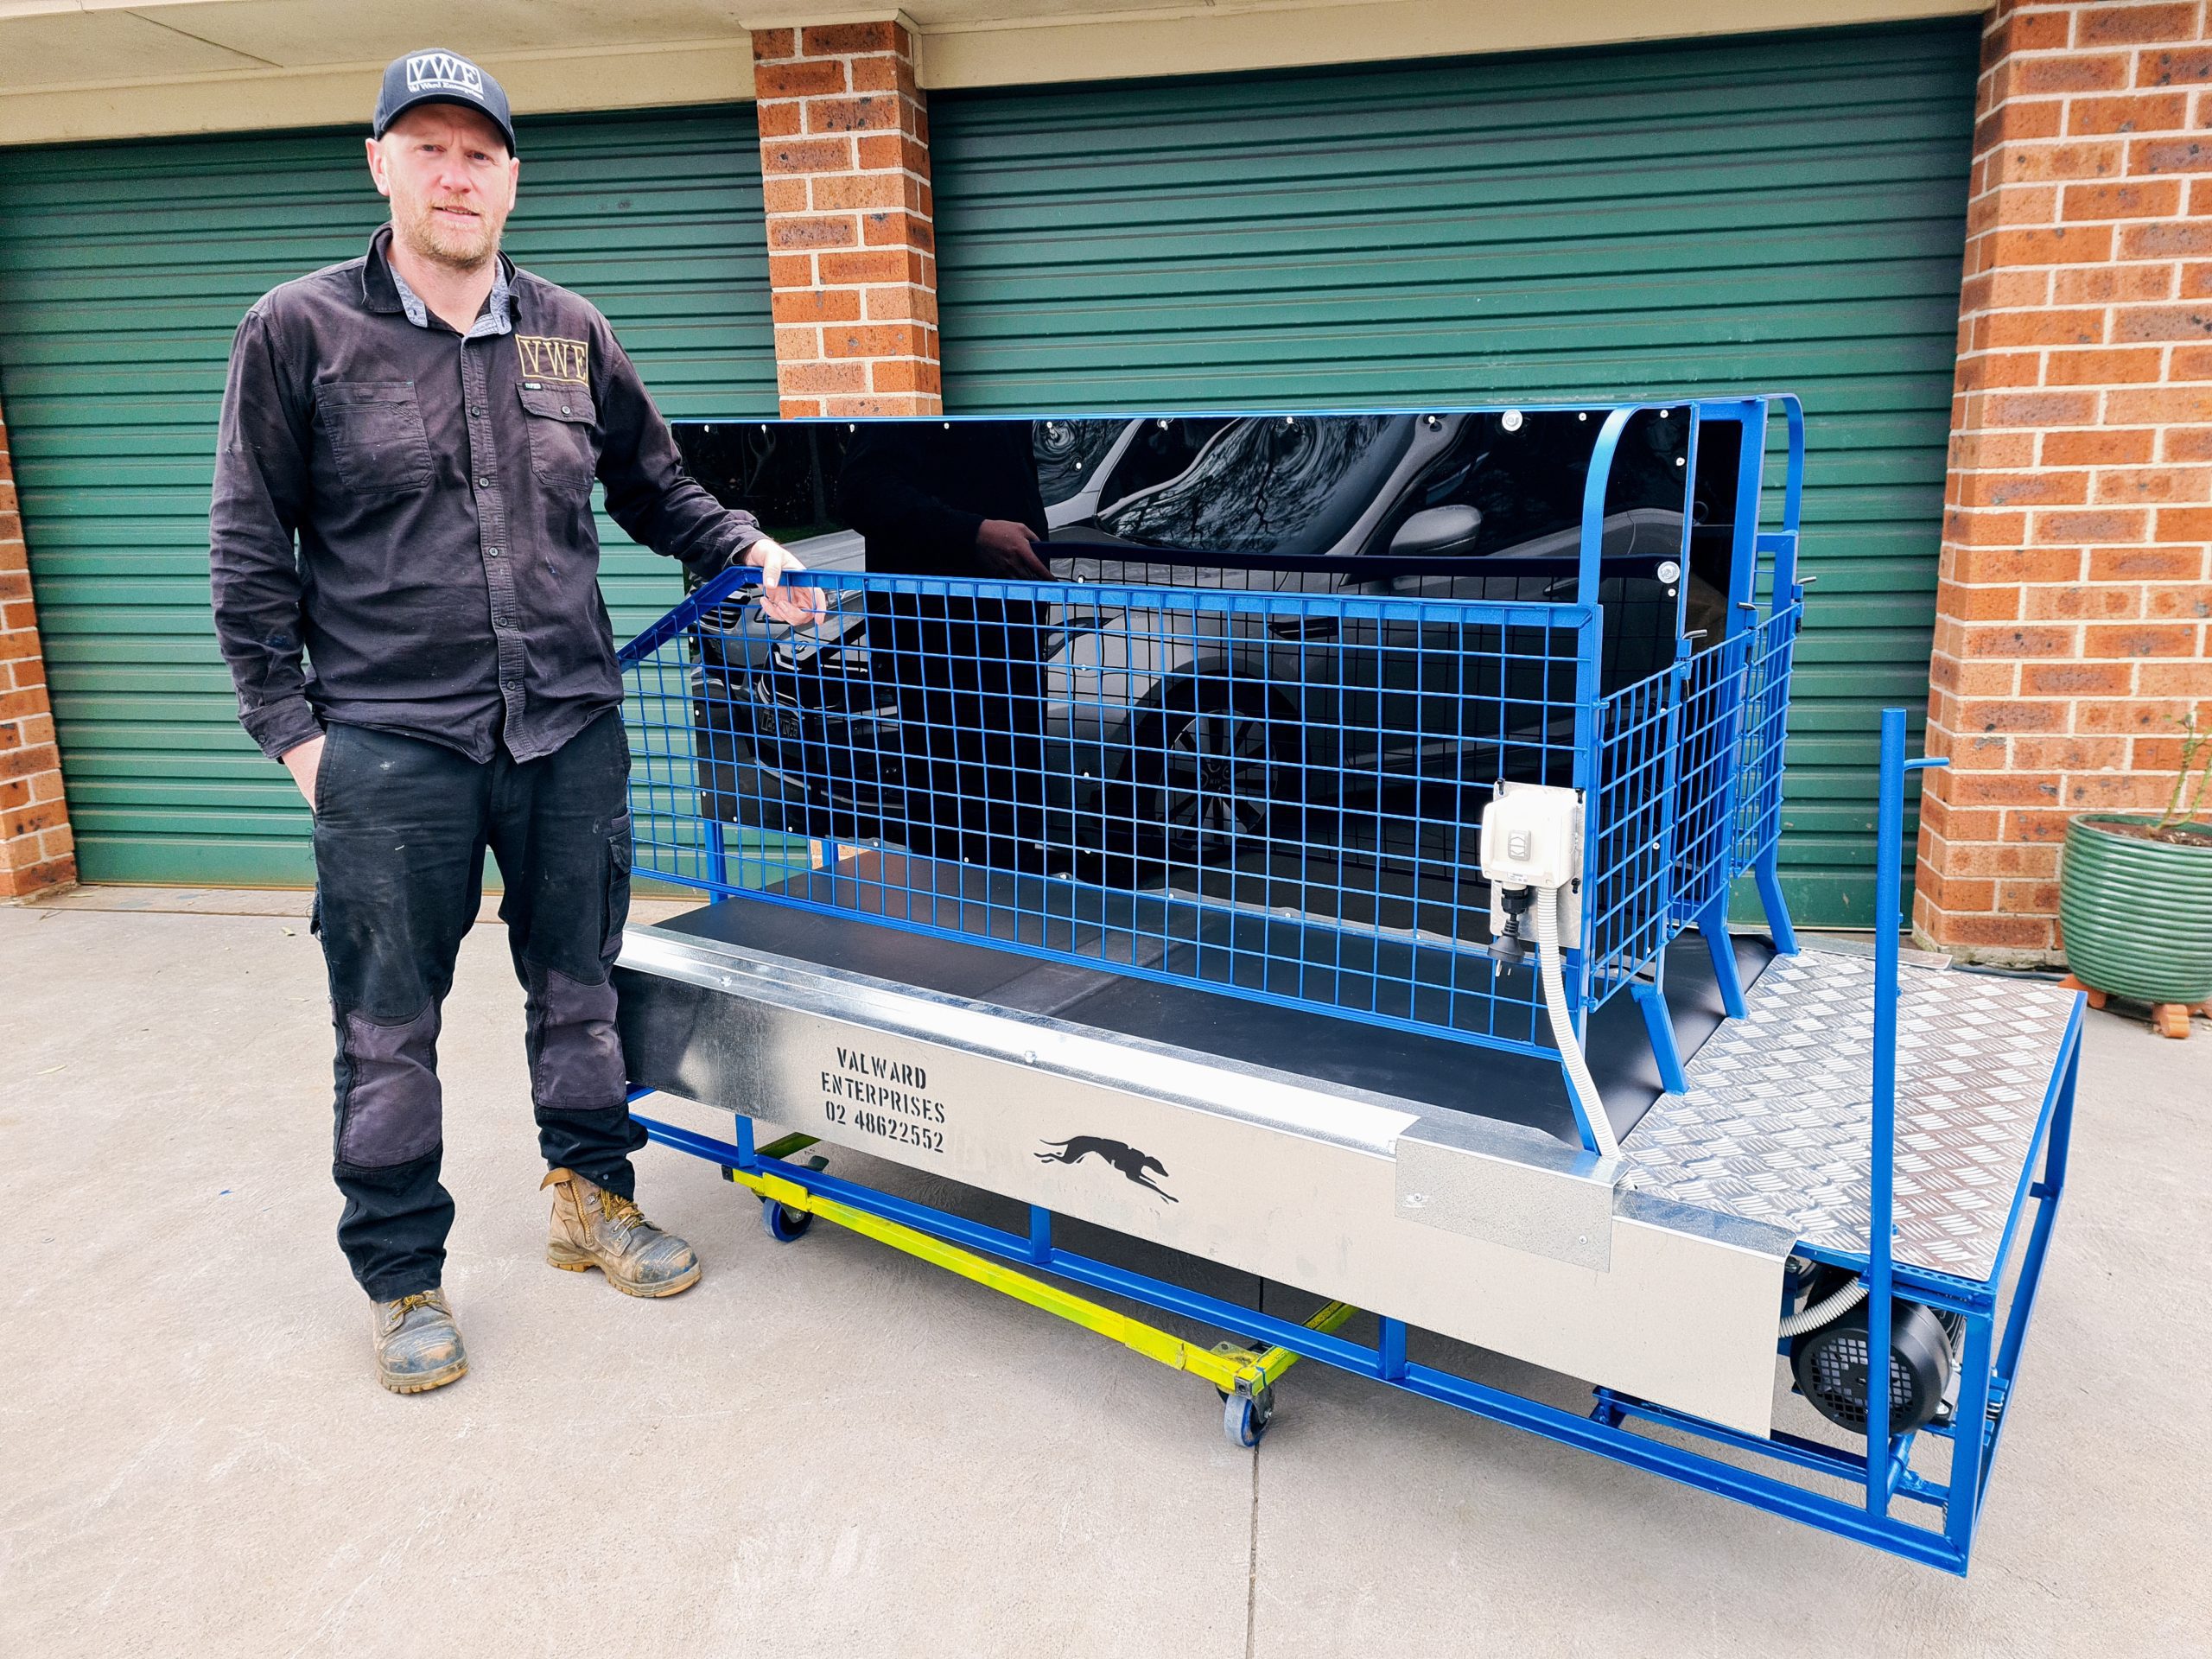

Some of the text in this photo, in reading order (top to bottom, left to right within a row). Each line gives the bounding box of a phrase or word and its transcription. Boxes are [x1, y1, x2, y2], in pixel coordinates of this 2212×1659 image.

[410, 54, 480, 90] VWE
[519, 340, 587, 380] VWE
[836, 1046, 926, 1090] VALWARD
[821, 1071, 945, 1124] ENTERPRISES
[825, 1100, 944, 1154] 02 48622552
